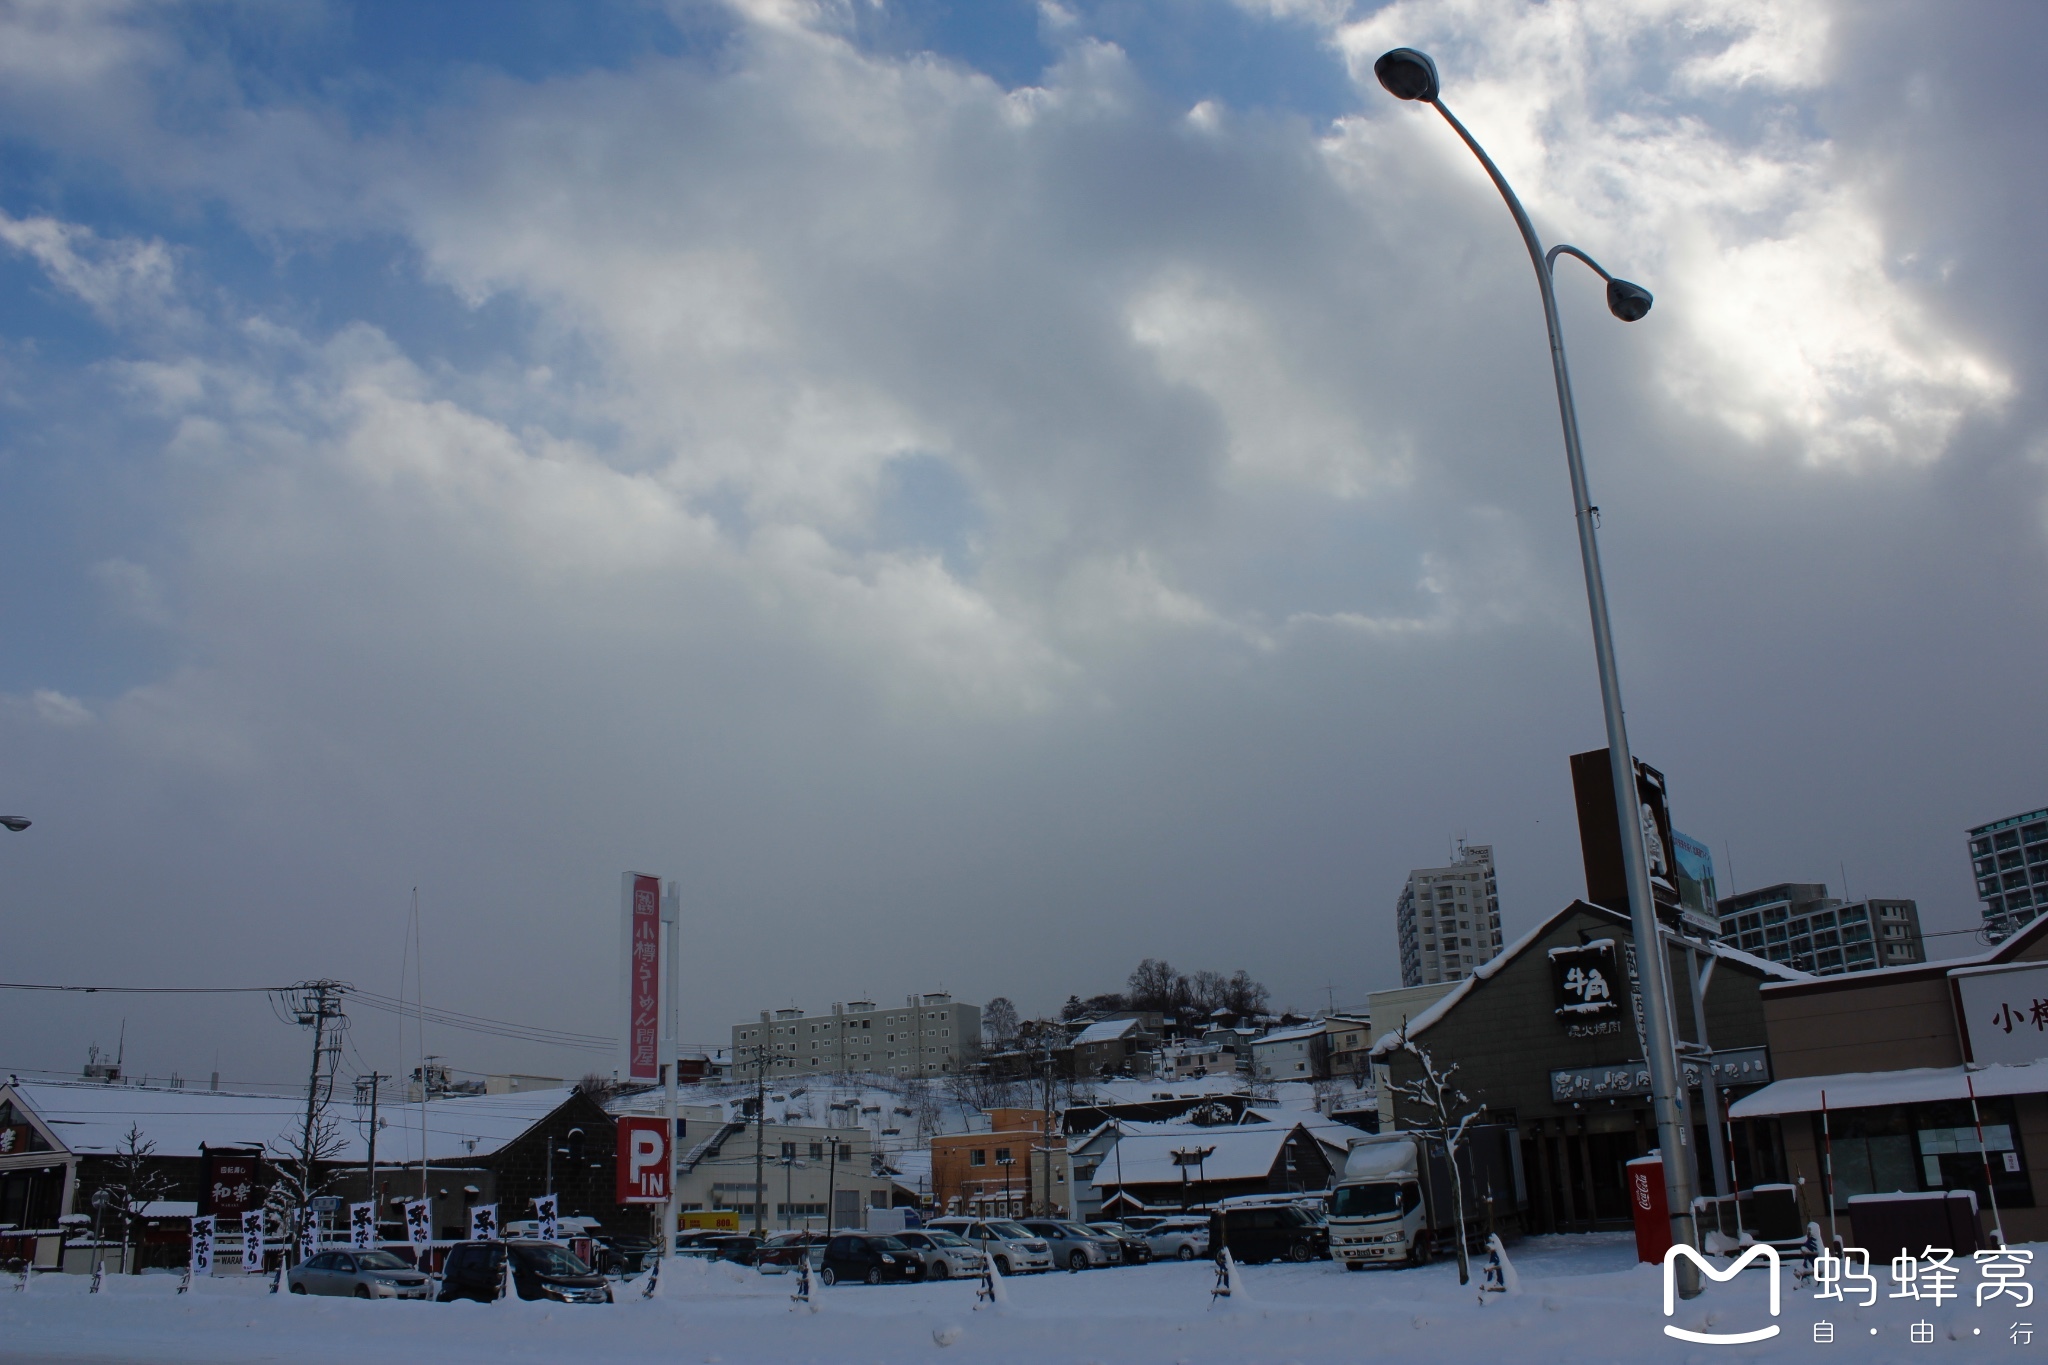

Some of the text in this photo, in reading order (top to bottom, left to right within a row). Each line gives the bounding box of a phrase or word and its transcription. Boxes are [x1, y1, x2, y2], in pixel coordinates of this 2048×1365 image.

[633, 921, 657, 1066] 小樽らーめん問屋
[1563, 967, 1610, 1002] 牛角
[630, 1129, 664, 1184] P
[212, 1182, 251, 1203] 和楽
[641, 1173, 664, 1196] IN
[192, 1220, 213, 1269] 寒ぶり
[243, 1215, 262, 1265] 寒ぶり
